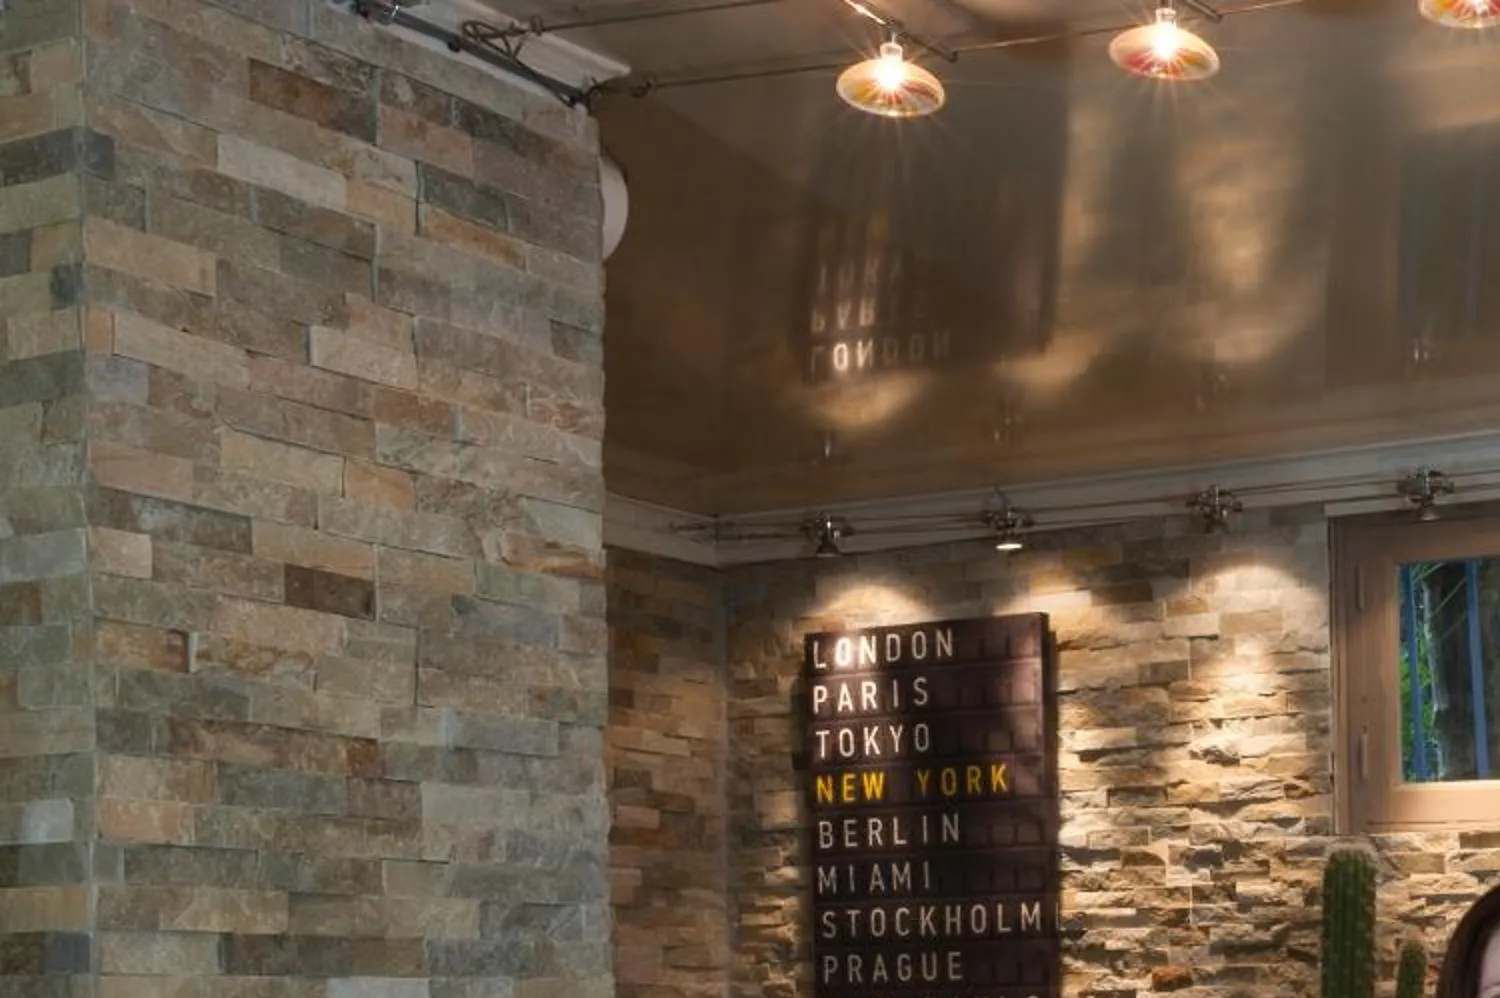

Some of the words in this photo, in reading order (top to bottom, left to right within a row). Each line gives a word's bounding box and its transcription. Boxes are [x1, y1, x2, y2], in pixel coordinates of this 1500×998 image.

[813, 628, 953, 669] LONDON
[813, 676, 929, 714] PARIS
[815, 723, 930, 759] TOKYO
[816, 771, 884, 803] NEW
[916, 763, 1008, 796] YORK
[818, 813, 960, 848] BERLIN
[818, 861, 930, 894] MIAMI
[822, 901, 1041, 938] STOCKHOLM
[823, 951, 963, 984] PRAGUE
